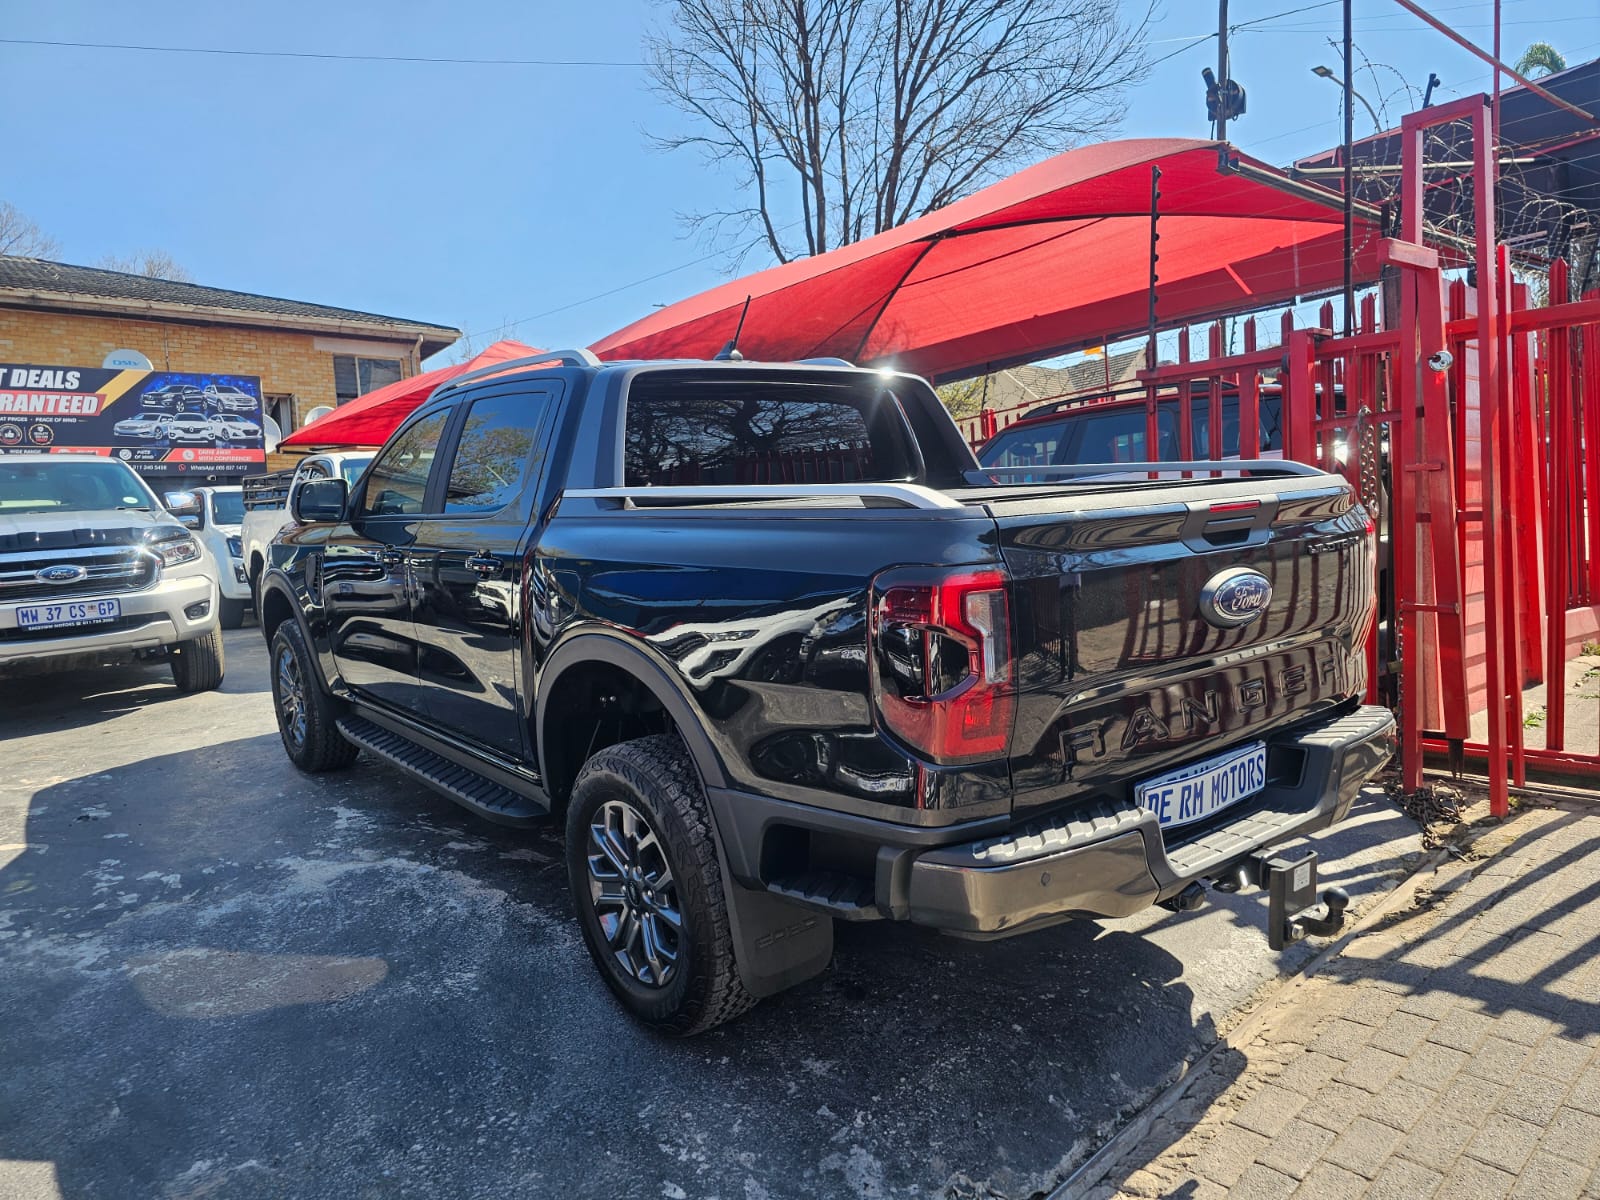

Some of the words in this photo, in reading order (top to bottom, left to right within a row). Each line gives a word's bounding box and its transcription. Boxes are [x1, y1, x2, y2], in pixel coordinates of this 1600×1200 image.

[10, 369, 80, 389] DEALS
[1231, 585, 1262, 611] Ford
[21, 608, 38, 624] MW
[46, 606, 62, 621] 37
[69, 604, 86, 619] CS
[98, 601, 115, 616] GP
[1058, 655, 1342, 778] RANGER
[1179, 780, 1204, 820] RM
[1211, 753, 1264, 809] MOTORS
